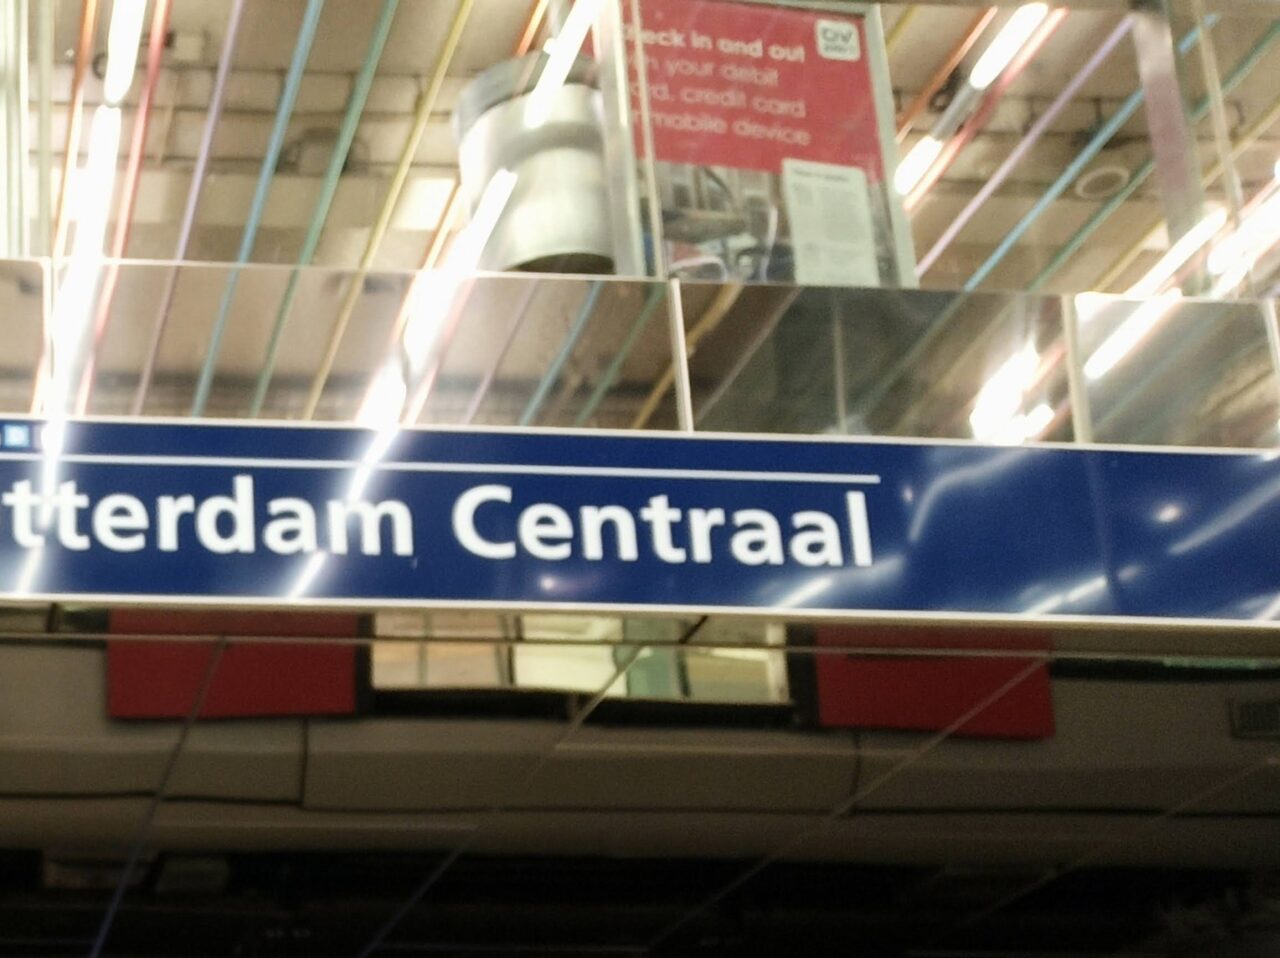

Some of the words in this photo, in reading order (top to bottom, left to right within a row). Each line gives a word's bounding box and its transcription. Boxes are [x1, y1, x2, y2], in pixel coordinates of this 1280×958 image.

[691, 29, 713, 49] in
[716, 36, 764, 59] and
[768, 43, 806, 63] out
[665, 57, 714, 78] your
[721, 63, 779, 87] debit
[679, 85, 747, 109] credit
[751, 96, 807, 119] card
[732, 117, 812, 147] device
[451, 483, 874, 567] Centraal
